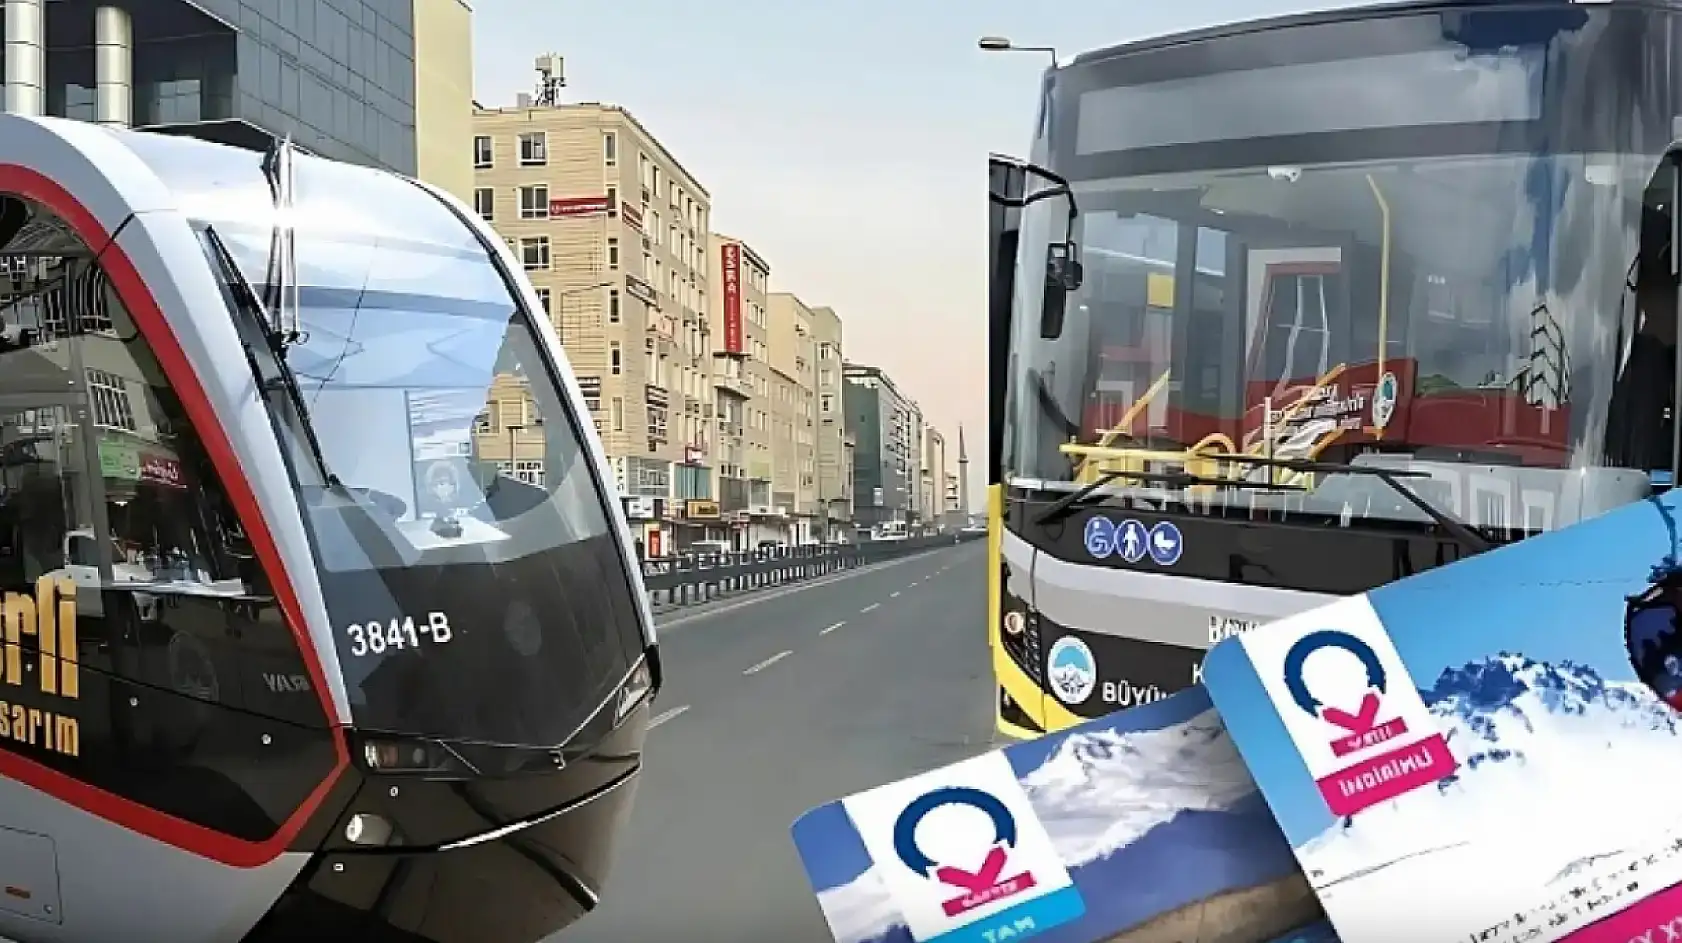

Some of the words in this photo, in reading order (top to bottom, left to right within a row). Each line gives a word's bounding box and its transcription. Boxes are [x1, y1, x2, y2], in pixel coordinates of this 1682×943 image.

[0, 576, 79, 699] rli
[347, 611, 453, 657] 3841-B
[1102, 680, 1169, 707] BÜYÜ
[0, 701, 79, 757] sarım
[982, 916, 1036, 943] TAM
